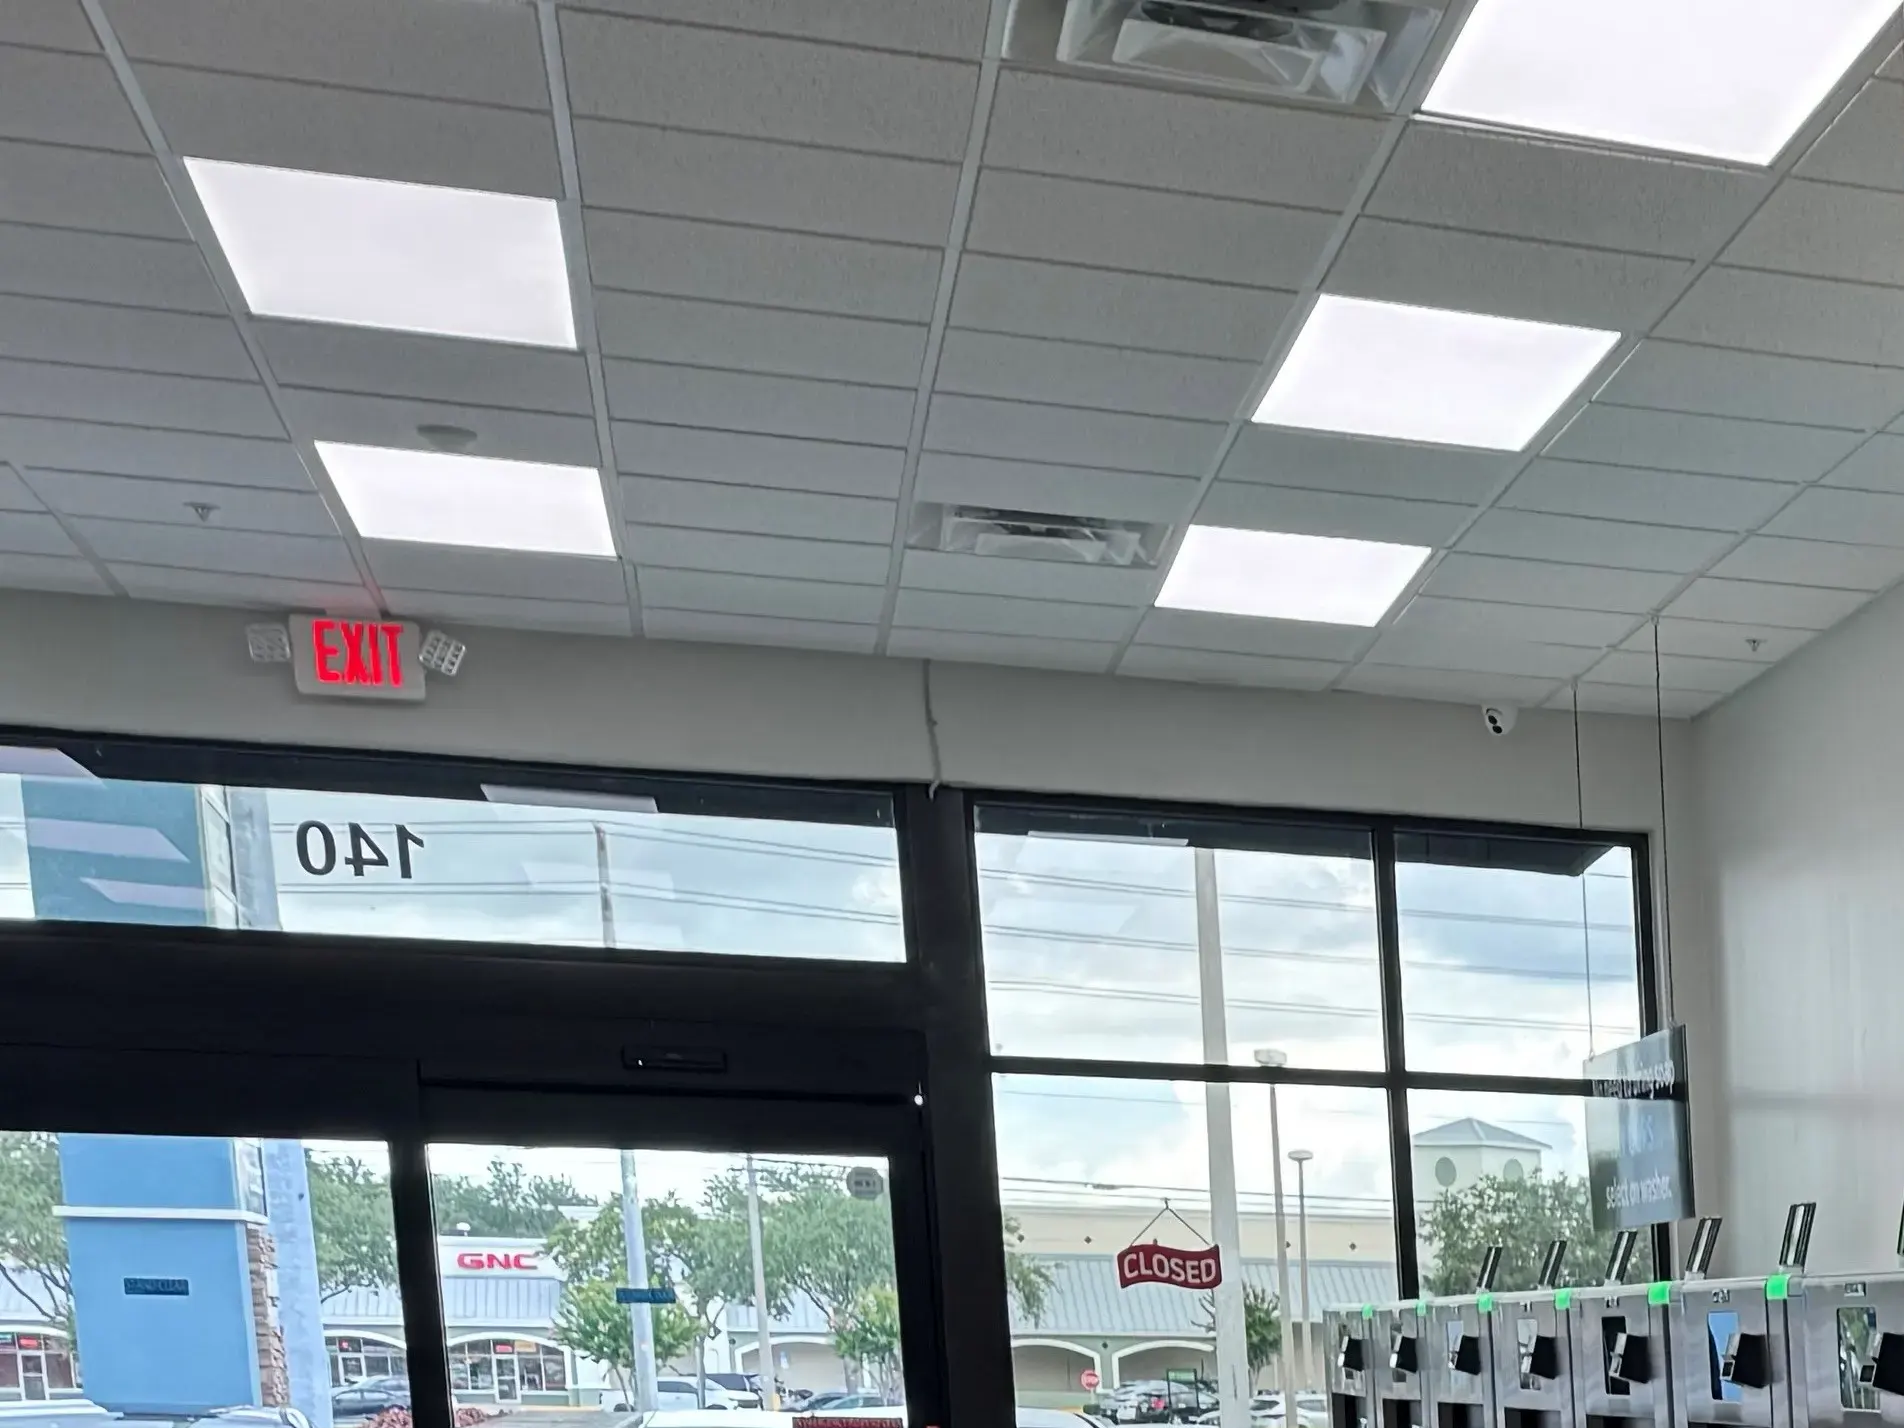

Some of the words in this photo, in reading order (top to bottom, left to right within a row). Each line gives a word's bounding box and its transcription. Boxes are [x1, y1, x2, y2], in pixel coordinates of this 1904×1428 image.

[312, 619, 404, 688] EXIT
[457, 1252, 538, 1270] GNC
[1123, 1251, 1216, 1284] CLOSED
